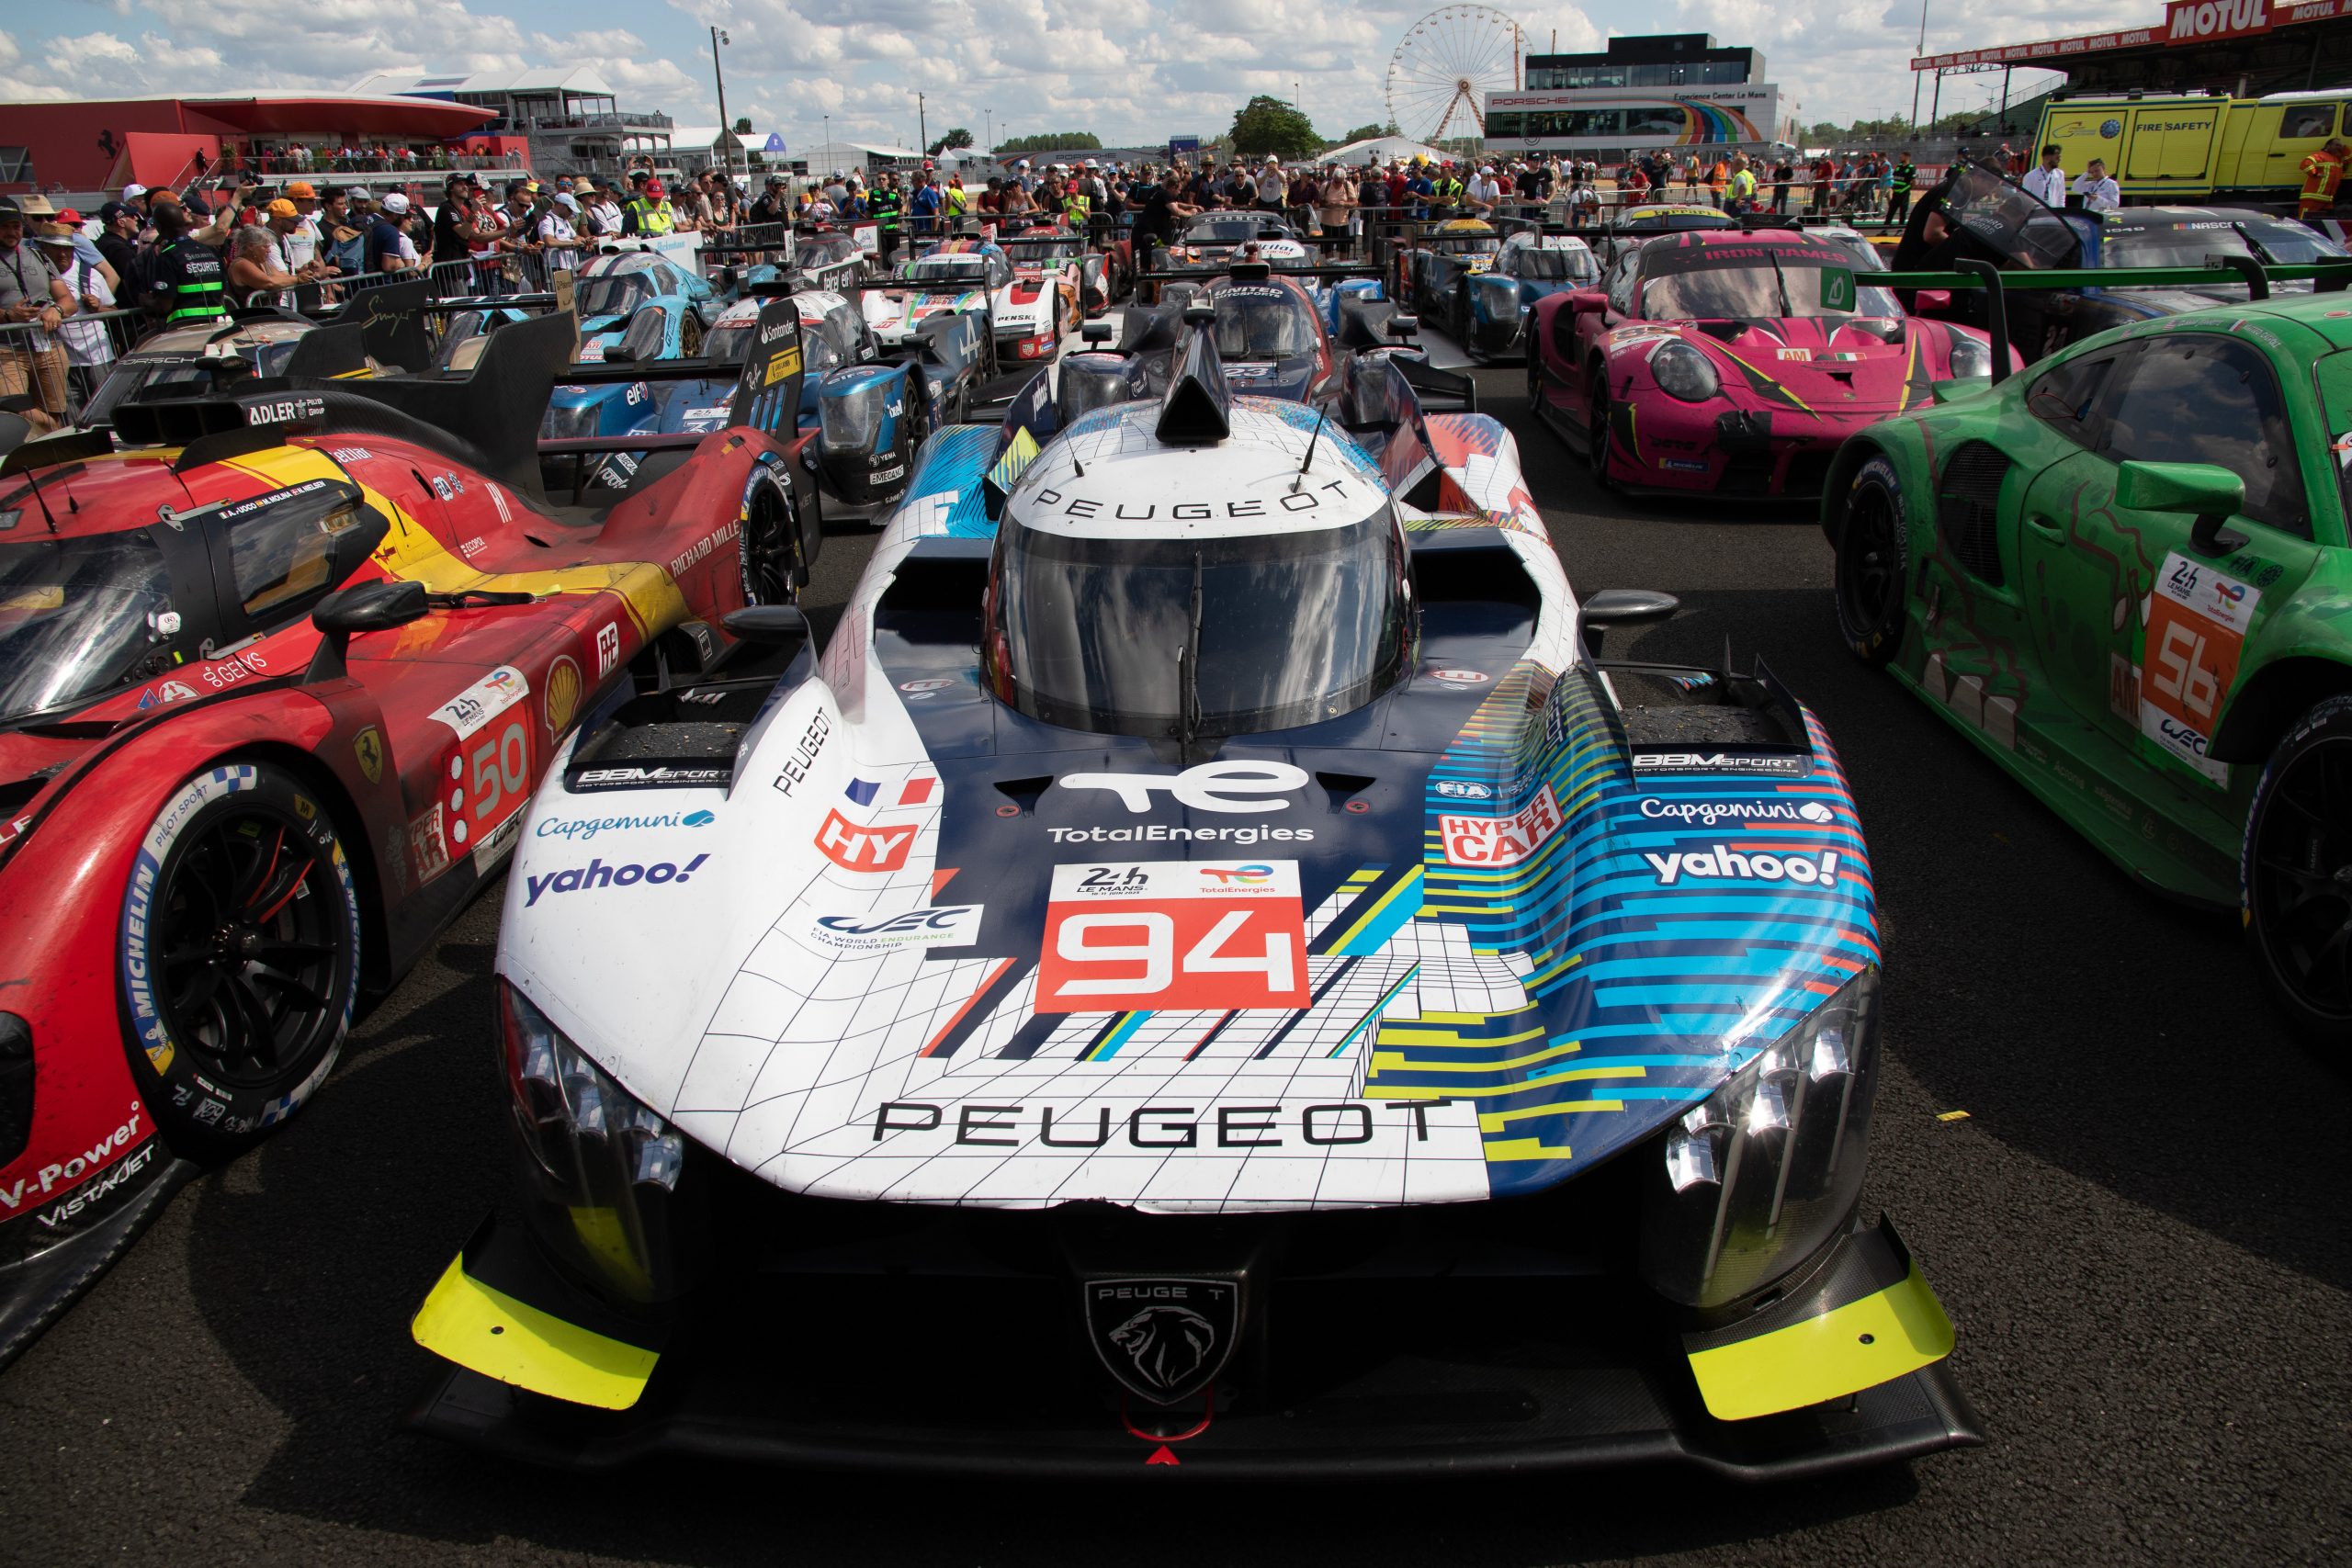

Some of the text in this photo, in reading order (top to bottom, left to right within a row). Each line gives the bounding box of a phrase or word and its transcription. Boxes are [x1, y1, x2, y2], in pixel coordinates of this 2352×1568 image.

[2170, 0, 2268, 40] MOTUL
[2292, 2, 2335, 20] MOTUL
[1913, 30, 2151, 68] MOTUL MOTUL MOTUL MOTUL MOTUL MOTUL MOTUL MOTUL MOTUL
[1491, 96, 1568, 107] PORSCHE
[1674, 93, 1710, 102] Experience
[1737, 91, 1746, 99] Le
[2135, 121, 2212, 132] FIRE SAFETY
[1654, 208, 1712, 216] Ferrari
[1705, 248, 1849, 263] IRON DAMES
[1214, 286, 1284, 297] UNITED
[1214, 291, 1281, 299] AUTOSPORTS
[768, 320, 795, 343] Santander
[1784, 351, 1806, 361] AM
[1224, 367, 1269, 377] 23
[627, 383, 640, 406] elf
[249, 401, 296, 426] ADLER
[879, 451, 897, 462] YEMA
[1863, 461, 1897, 490] MICHELIN
[268, 491, 292, 503] MOLINA
[303, 480, 327, 493] NIELSEN
[1033, 479, 1351, 520] PEUGEOT
[670, 519, 741, 578] RICHARD MILLE
[2171, 560, 2199, 590] 24h
[2176, 584, 2191, 598] MANS
[218, 652, 267, 683] GENYS
[2153, 619, 2220, 719] 56
[446, 698, 481, 719] 24h
[470, 707, 485, 722] MANS
[2161, 719, 2207, 755] WEC
[773, 706, 831, 797] PEUGEOT
[471, 723, 527, 821] 50
[576, 780, 649, 789] MOTORSPORT
[1440, 784, 1487, 796] FIA
[155, 784, 208, 848] PILOT SPORT
[1448, 793, 1546, 836] HYPER
[1640, 797, 1799, 825] Capgemini
[537, 811, 680, 840] Capgemini
[1047, 824, 1315, 844] TotalEnergies
[1452, 806, 1555, 863] CAR
[821, 818, 911, 864] HY
[1080, 866, 1148, 886] 24h
[1645, 844, 1838, 886] yahoo!
[525, 853, 711, 908] yahoo!
[817, 908, 972, 934] WEC
[128, 863, 156, 1018] MICHELIN
[810, 931, 902, 950] CHAMPIONSHIP
[812, 926, 956, 945] FIA WORLD ENDURANCE
[1054, 910, 1295, 996] 94
[872, 1100, 1453, 1148] PEUGEOT
[0, 1113, 141, 1210] V-Power
